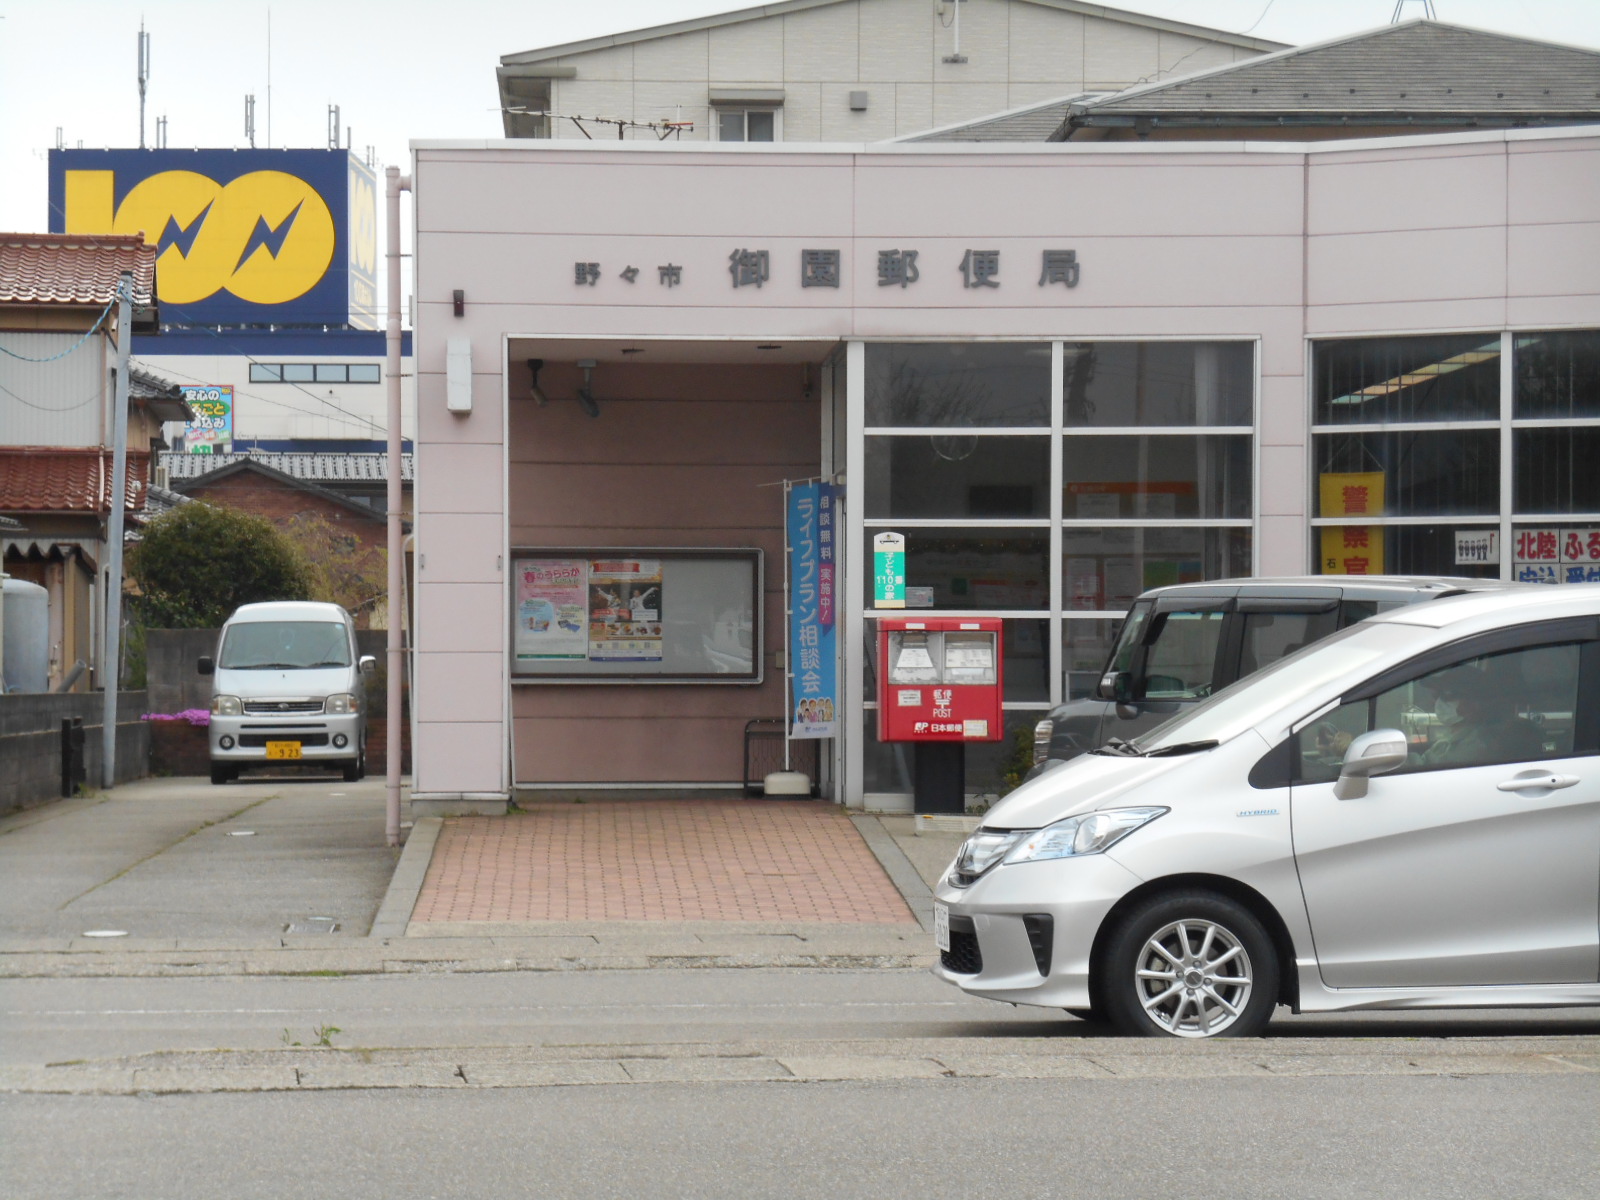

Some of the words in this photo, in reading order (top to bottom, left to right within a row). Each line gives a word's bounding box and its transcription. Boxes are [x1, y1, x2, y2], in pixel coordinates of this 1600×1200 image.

[797, 498, 820, 693] ライフプラン相談会
[933, 689, 952, 700] 郵便
[933, 708, 952, 718] POST
[931, 723, 962, 732] 日本郵便
